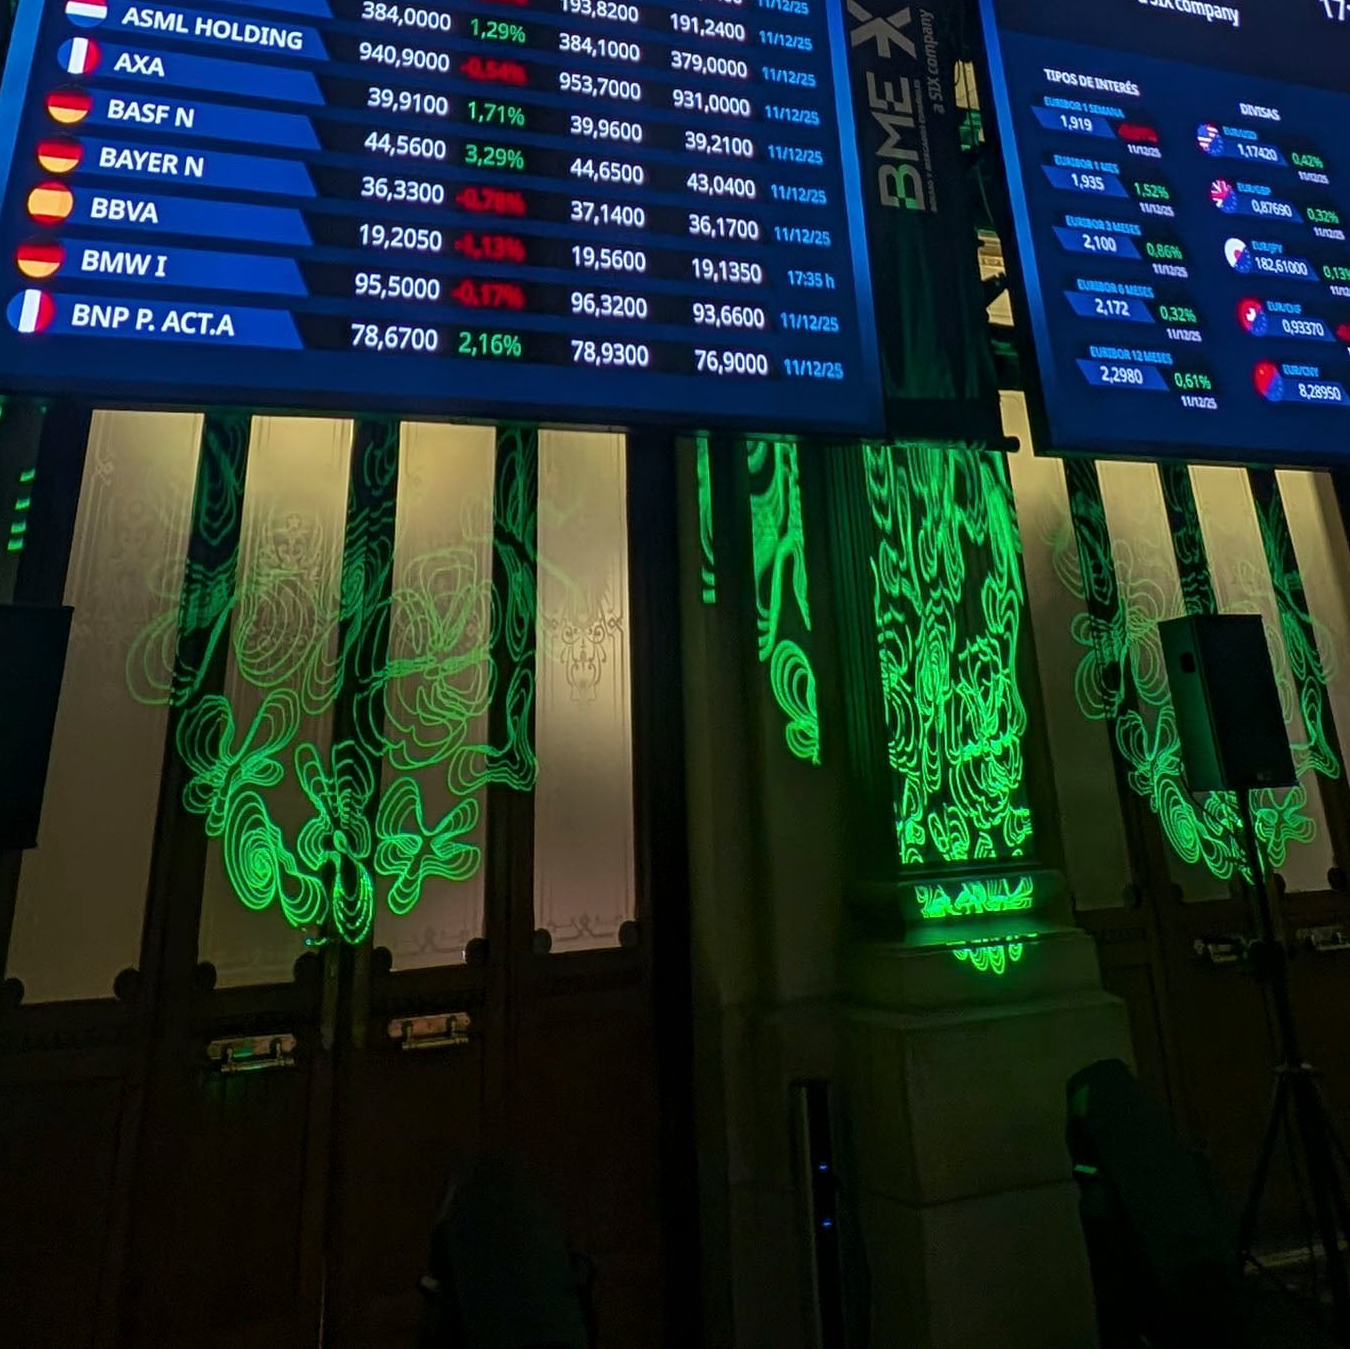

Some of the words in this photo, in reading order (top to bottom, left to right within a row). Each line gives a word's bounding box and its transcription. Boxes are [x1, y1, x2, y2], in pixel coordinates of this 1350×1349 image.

[122, 7, 188, 33] ASML
[195, 17, 302, 49] HOLDING
[114, 53, 164, 77] AXA
[1044, 69, 1078, 86] TIPOS
[1079, 75, 1094, 88] DE
[1095, 77, 1140, 97] INTERÉS
[108, 99, 169, 124] BASF
[175, 108, 194, 128] N
[1060, 115, 1092, 132] 1,919
[866, 71, 926, 211] BME
[99, 147, 178, 174] BAYER
[184, 156, 204, 177] N
[1071, 173, 1105, 191] 1,935
[91, 197, 158, 223] BBVA
[1083, 234, 1117, 252] 2,100
[81, 250, 151, 275] BMW
[155, 256, 167, 277] I
[1094, 297, 1130, 317] 2,172
[72, 304, 129, 328] BNP
[136, 309, 154, 330] P.
[161, 311, 234, 336] ACT.A
[352, 324, 438, 350] 78,6700
[459, 332, 521, 356] 2,16%
[572, 340, 649, 366] 78,9300
[695, 350, 768, 374] 76,9000
[784, 359, 843, 379] 11/12/25
[1100, 366, 1143, 384] 2,2980
